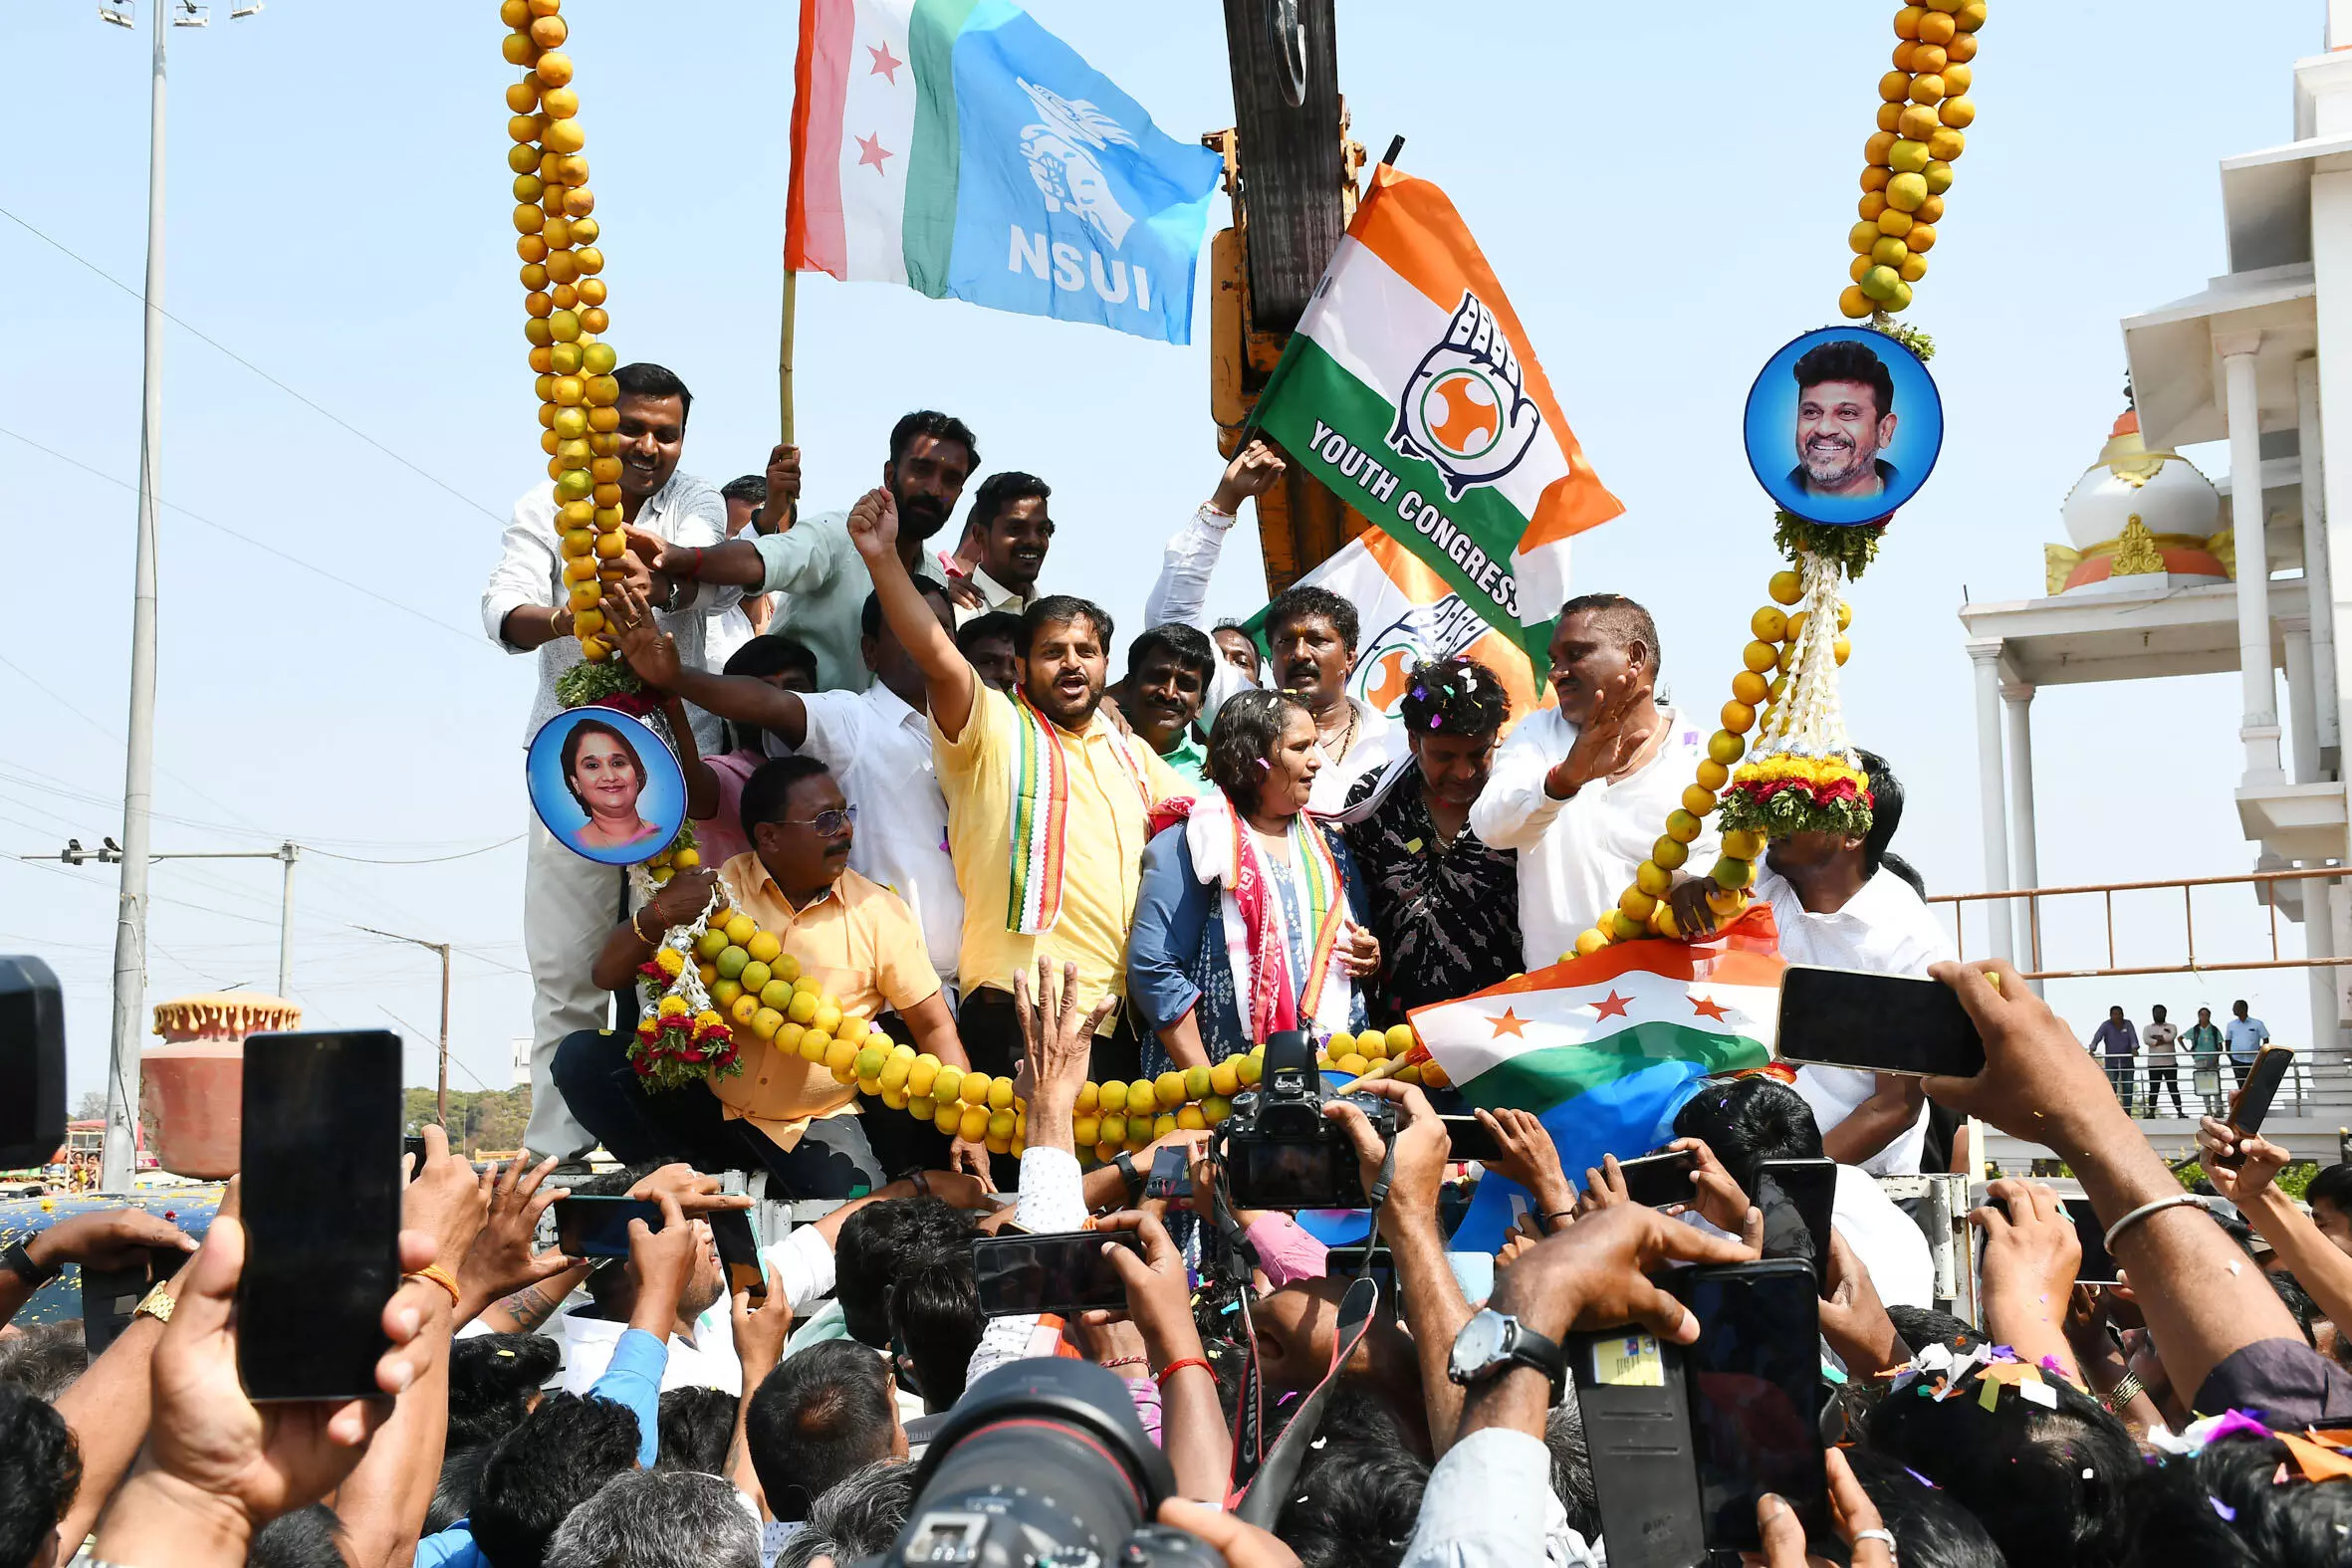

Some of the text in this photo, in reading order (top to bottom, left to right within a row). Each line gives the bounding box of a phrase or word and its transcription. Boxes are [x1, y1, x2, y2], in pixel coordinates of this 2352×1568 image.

[1009, 224, 1150, 312] NSUI
[1308, 418, 1400, 503] YOUTH
[1243, 1367, 1257, 1463] Canon
